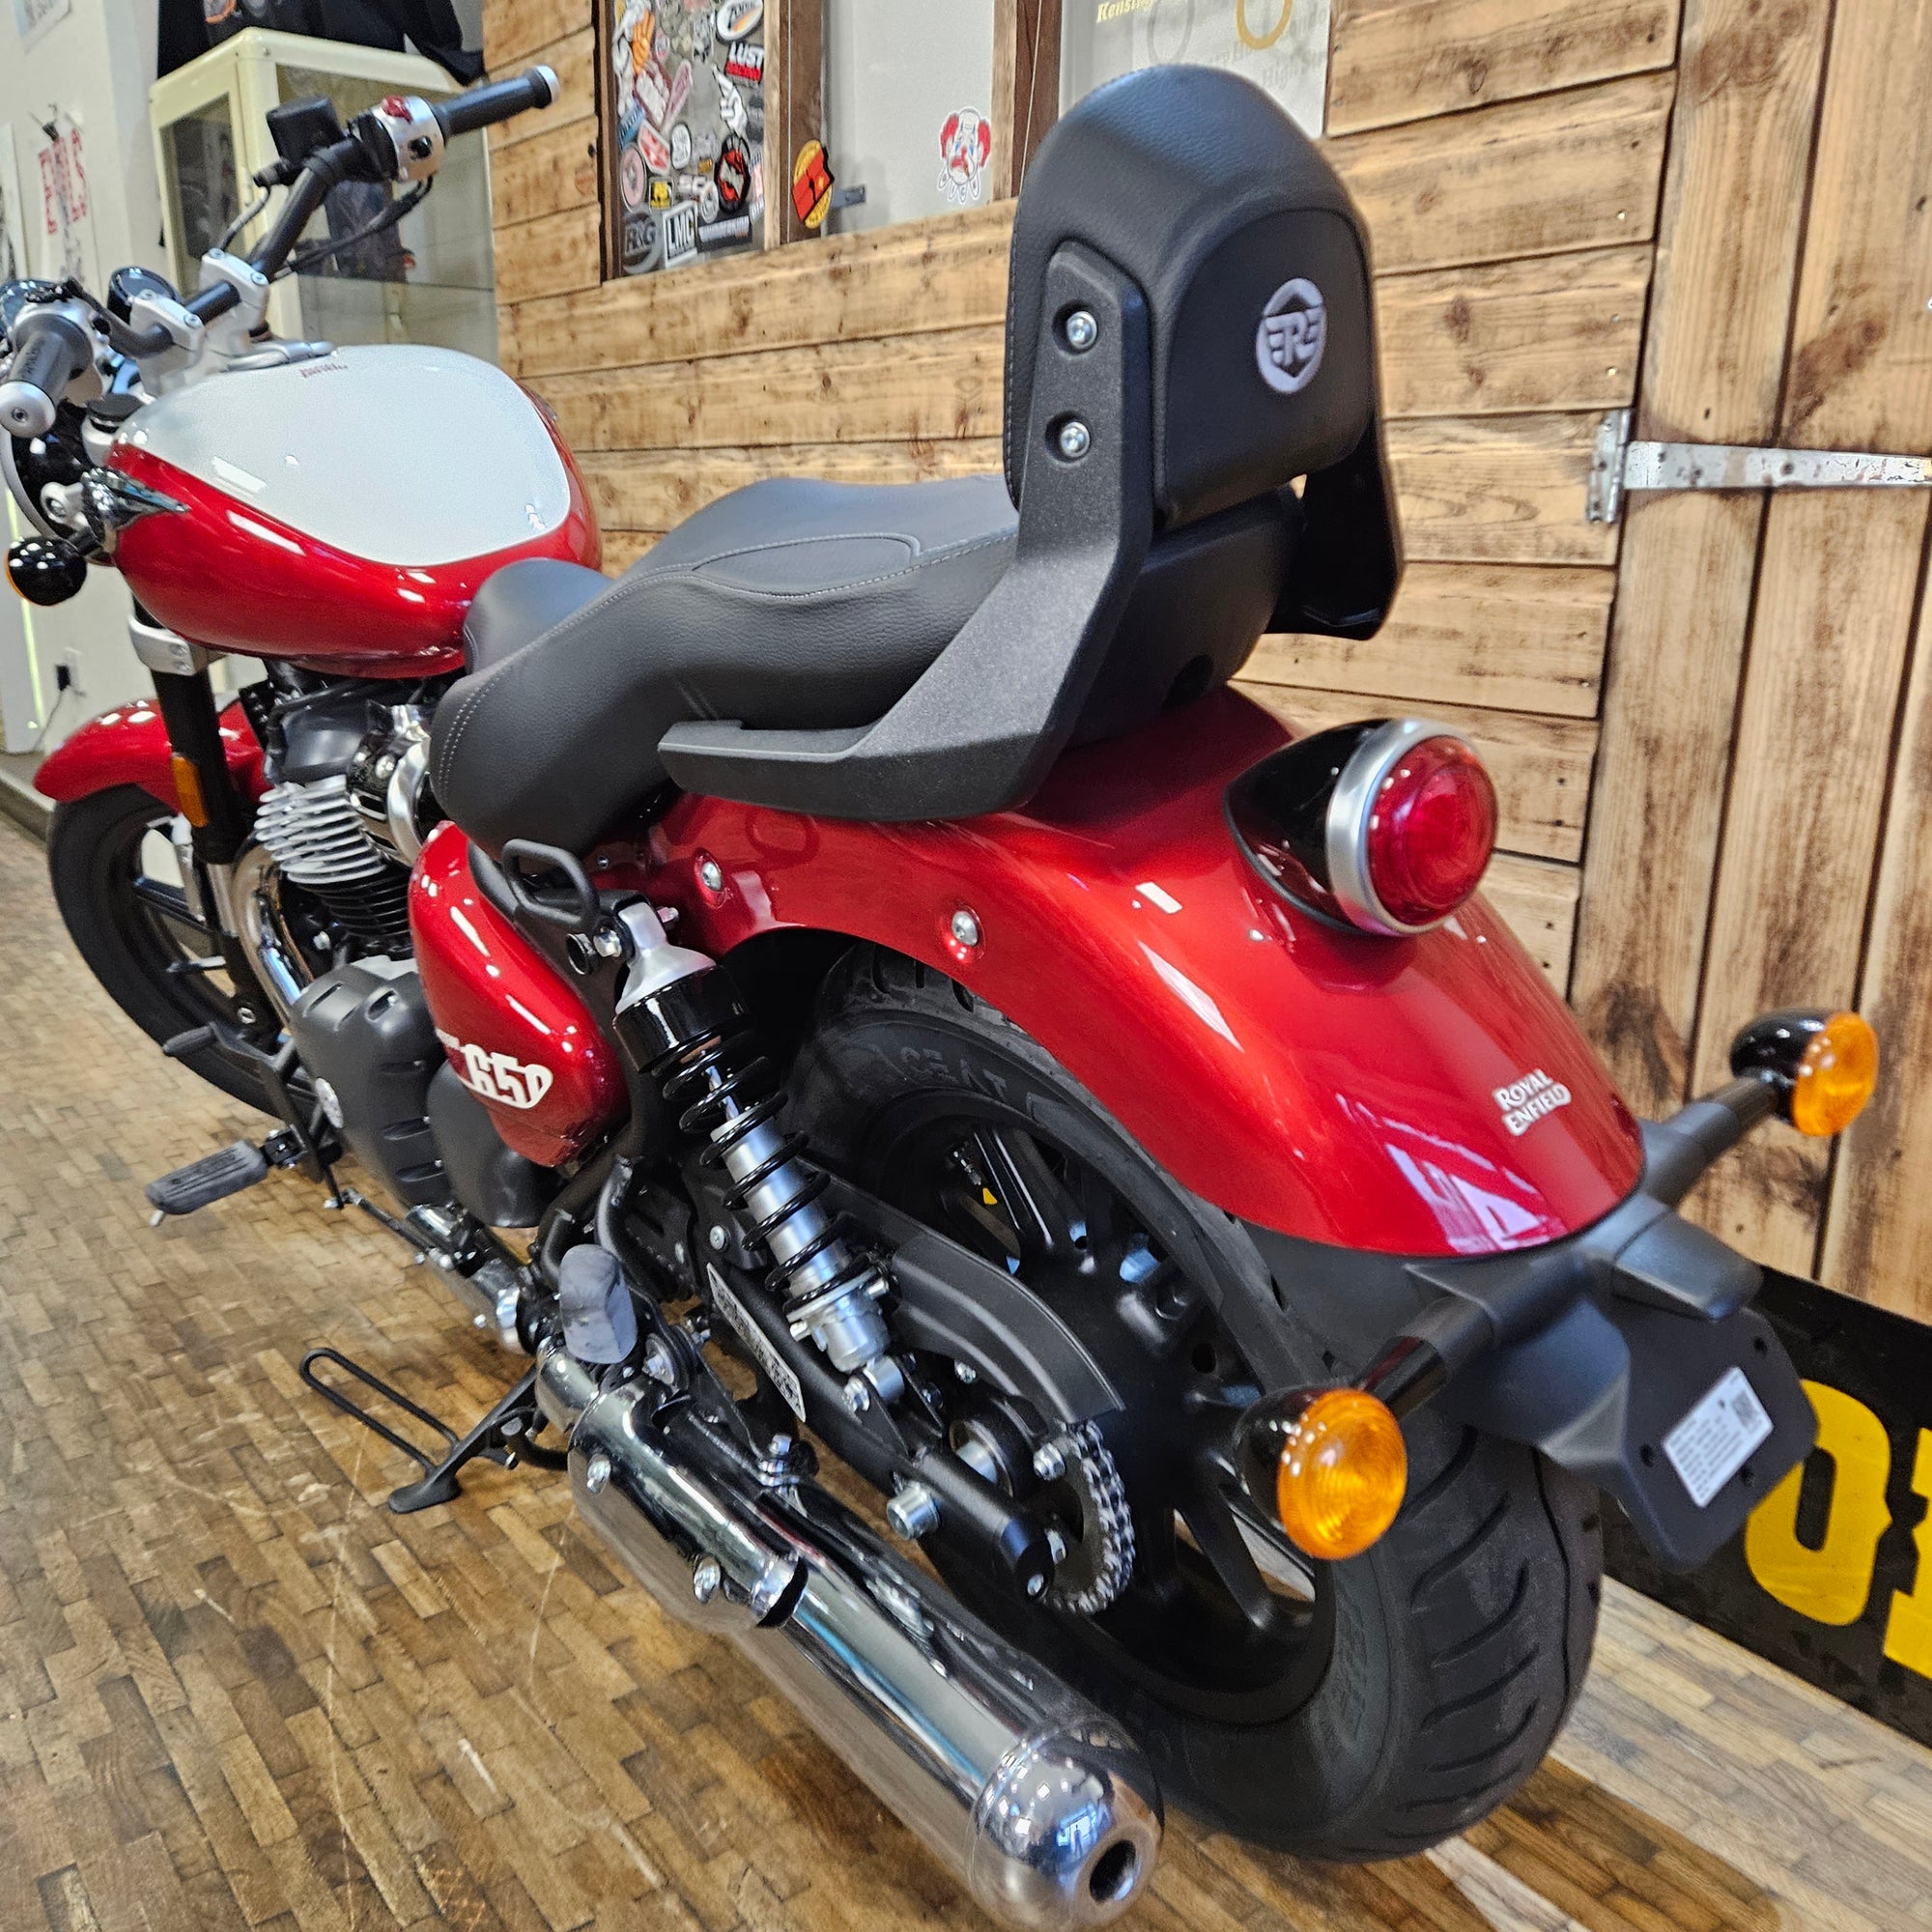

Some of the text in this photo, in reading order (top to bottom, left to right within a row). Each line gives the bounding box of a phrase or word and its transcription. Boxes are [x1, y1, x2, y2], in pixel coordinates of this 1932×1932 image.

[464, 1043, 554, 1109] 650
[1492, 1068, 1554, 1111] ROYAL
[1502, 1082, 1573, 1136] ENFIELD
